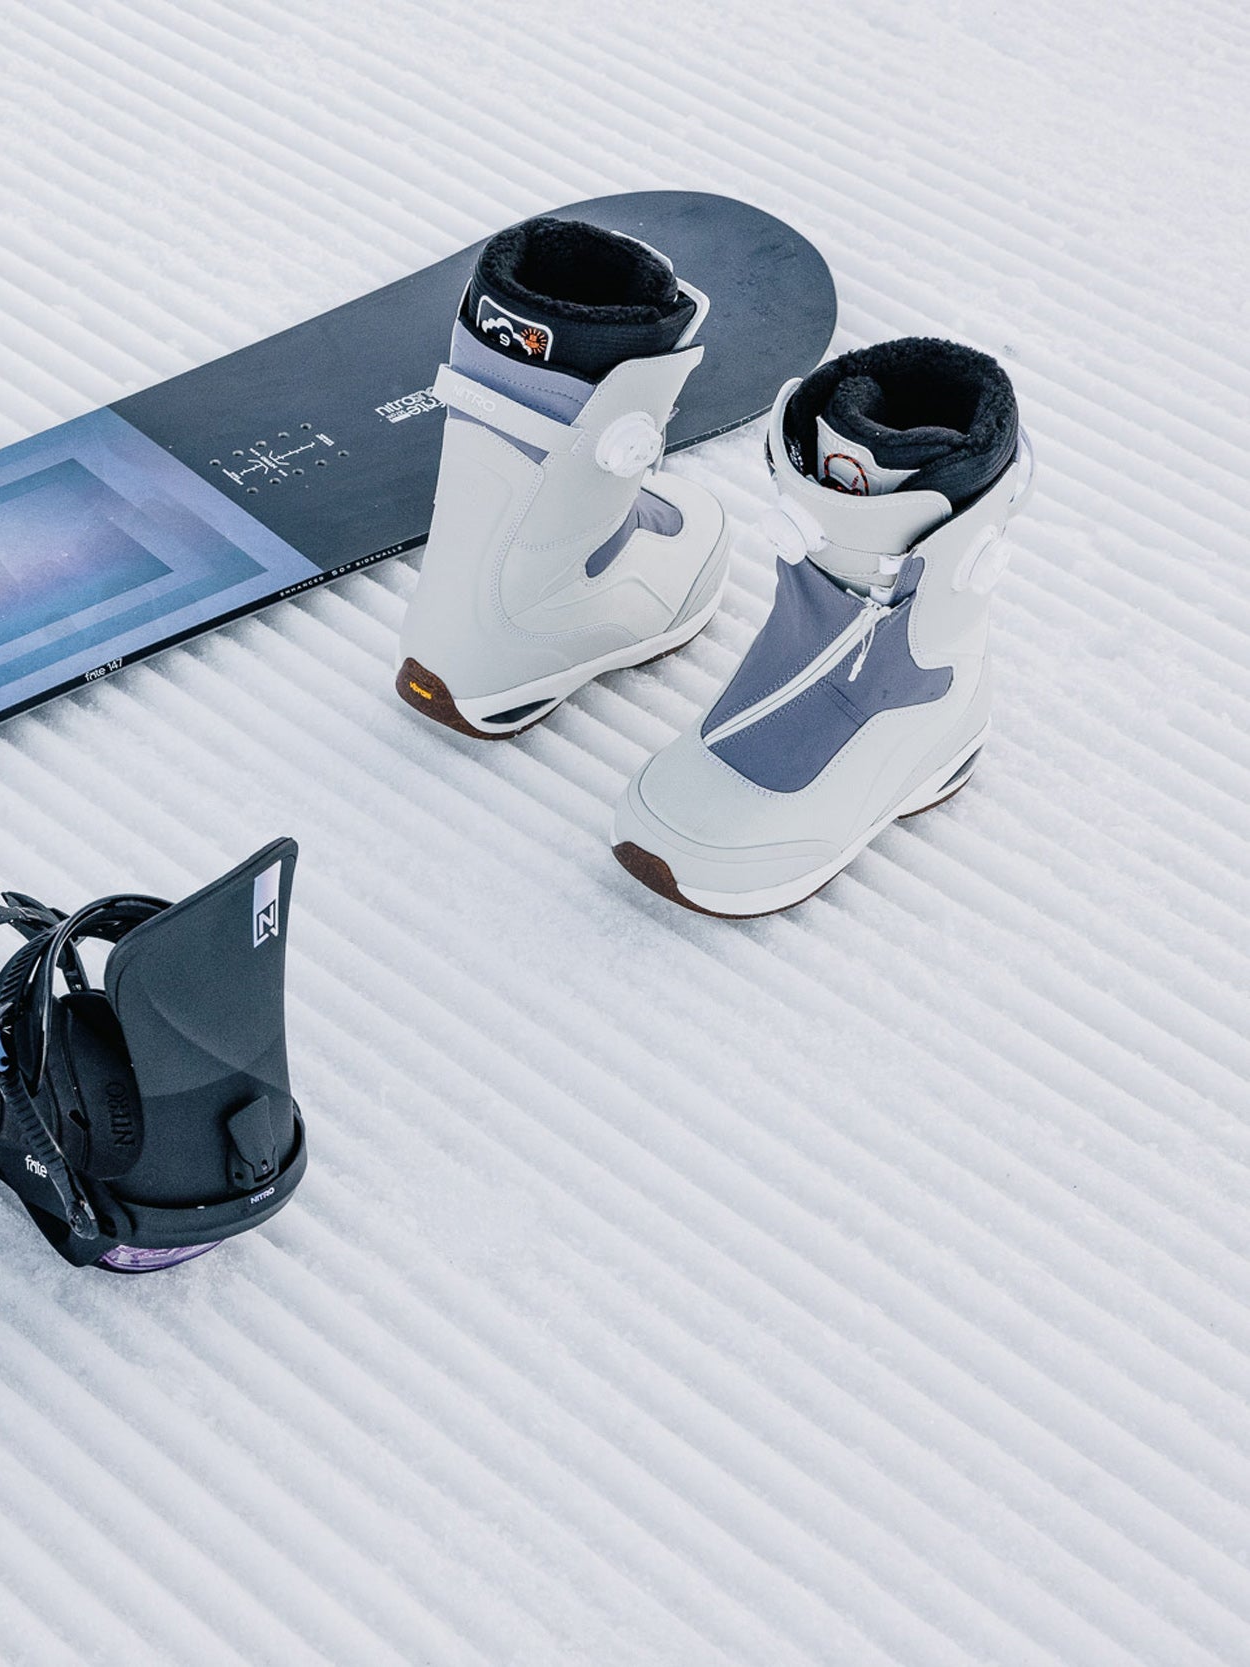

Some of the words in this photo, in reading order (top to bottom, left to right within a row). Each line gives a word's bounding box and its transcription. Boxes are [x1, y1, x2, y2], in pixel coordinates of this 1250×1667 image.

[453, 384, 497, 412] NITRO
[279, 575, 325, 598] ENHANCED
[355, 545, 403, 567] SIDEWALLS
[107, 657, 123, 672] 147
[250, 1187, 275, 1204] NITRO
